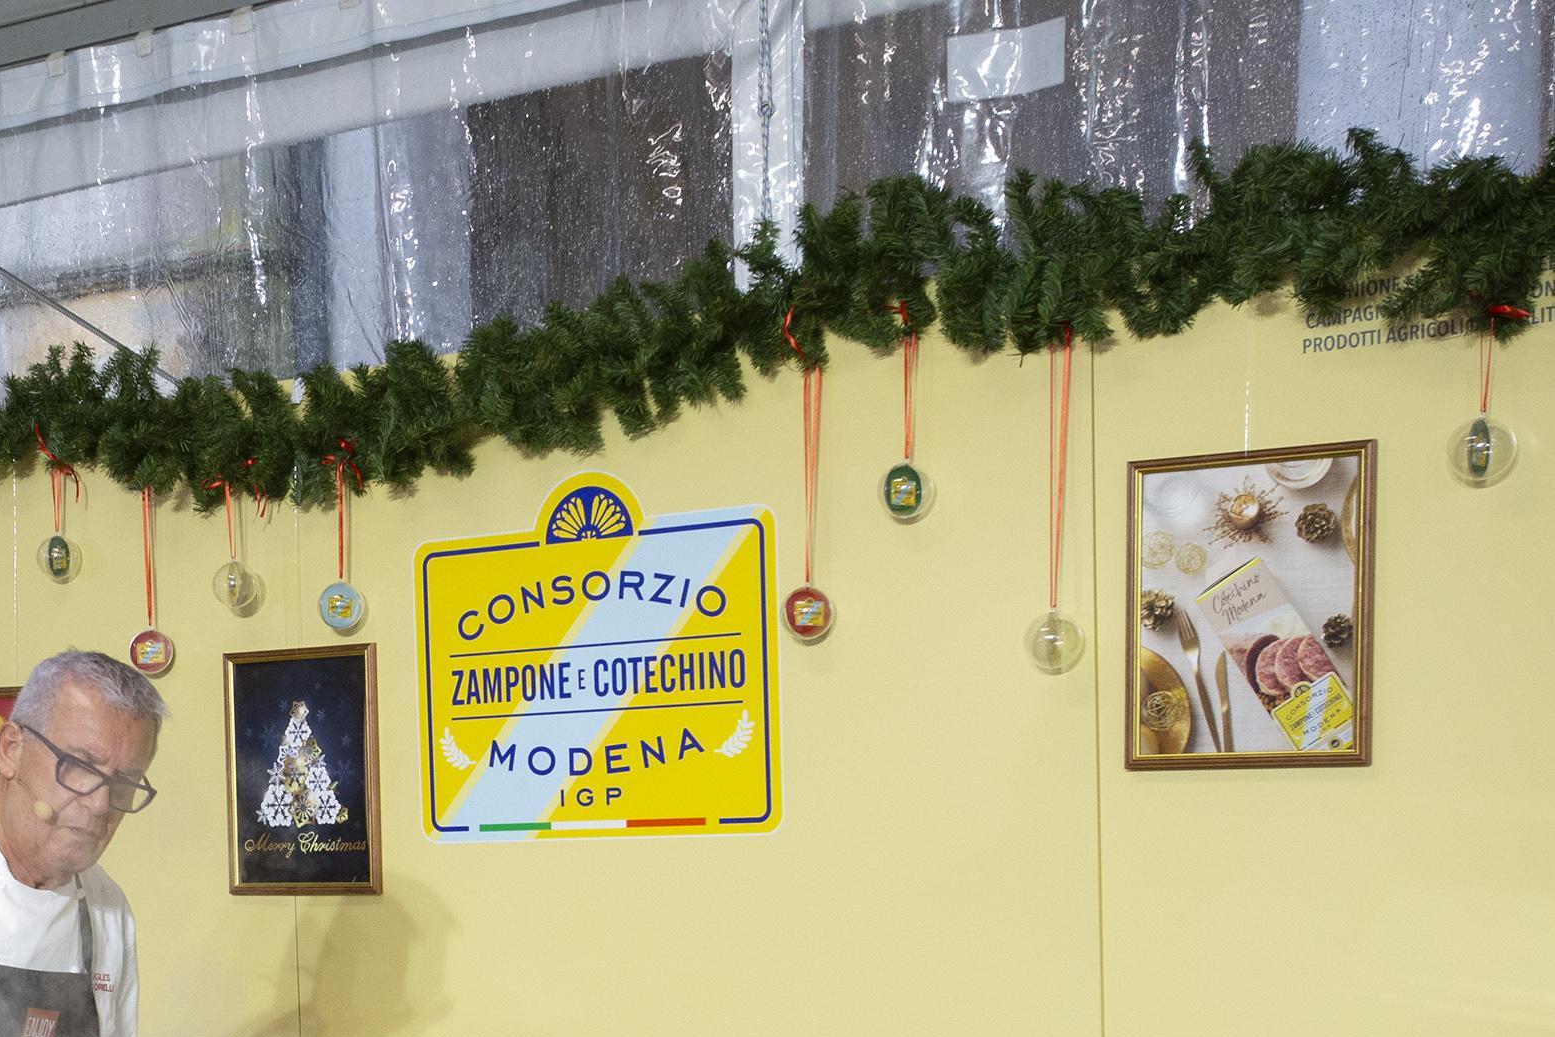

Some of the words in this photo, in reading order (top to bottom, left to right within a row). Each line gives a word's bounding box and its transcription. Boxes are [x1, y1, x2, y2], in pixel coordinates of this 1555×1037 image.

[1303, 329, 1381, 354] PRODOTTI
[1386, 319, 1465, 344] AGRICOLI
[457, 570, 727, 641] CONSORZIO
[1222, 593, 1266, 625] Modena
[451, 662, 571, 706] ZAMPONE
[578, 669, 586, 690] E
[594, 648, 746, 698] COTECHINO
[488, 728, 705, 776] MODENA
[560, 787, 622, 807] IGP
[244, 832, 295, 859] Merry
[297, 831, 367, 855] Christmas
